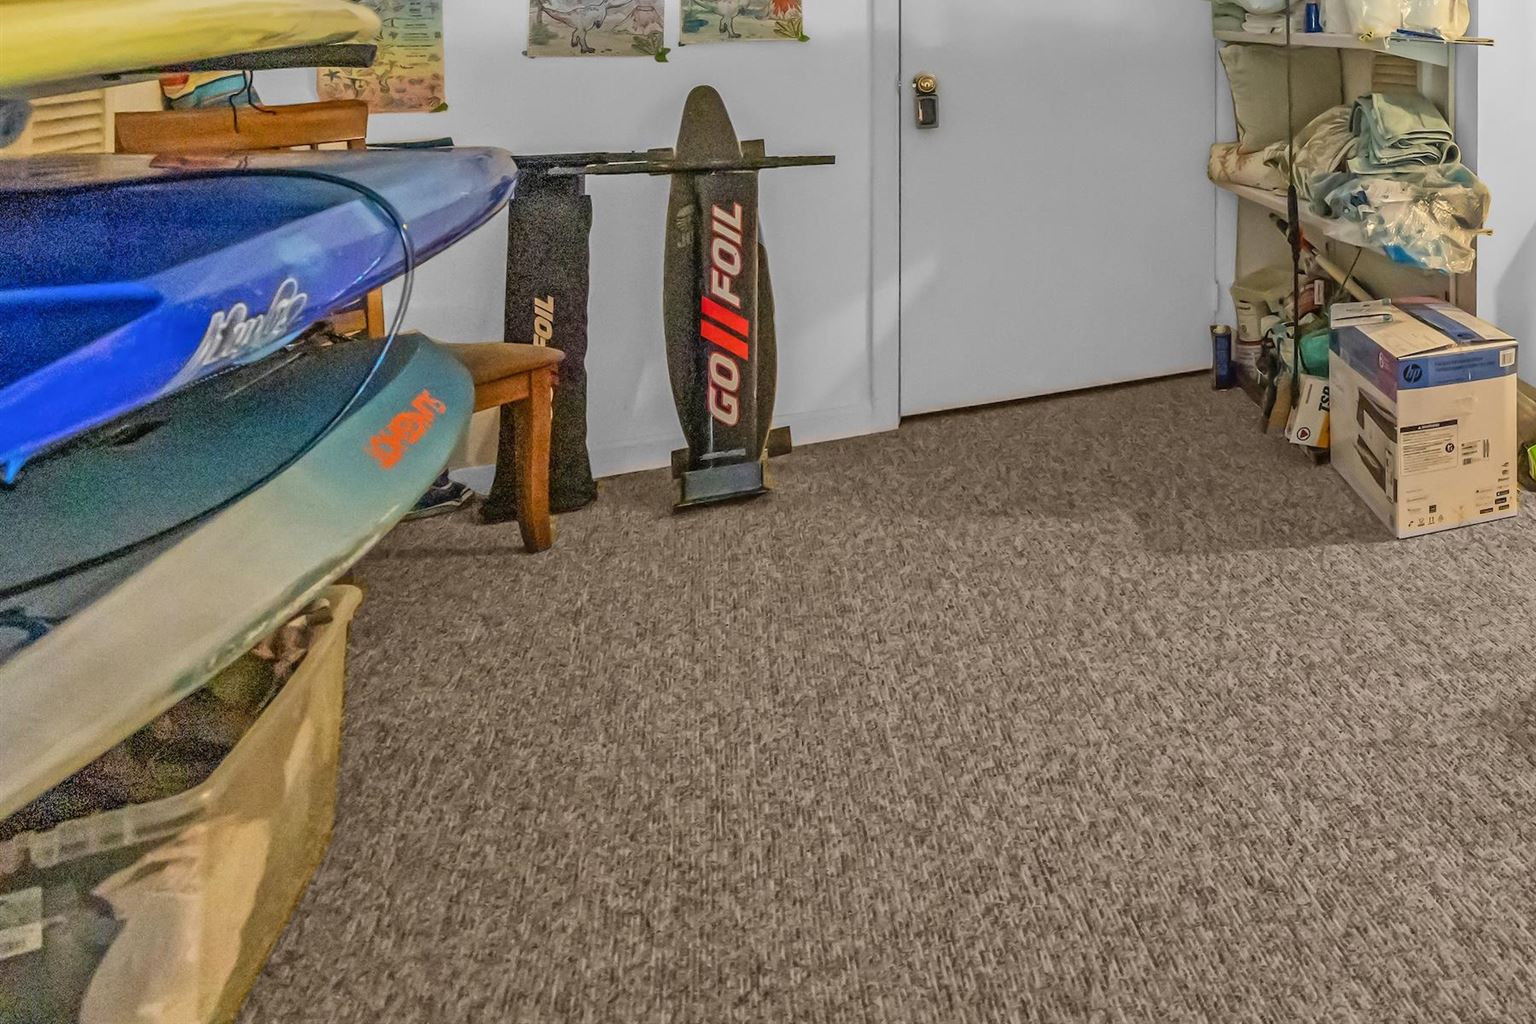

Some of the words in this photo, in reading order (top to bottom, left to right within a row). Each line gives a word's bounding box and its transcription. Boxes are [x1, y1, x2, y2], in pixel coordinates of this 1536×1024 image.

[711, 201, 743, 309] FOIL
[708, 351, 741, 427] GO
[1405, 363, 1420, 384] hp
